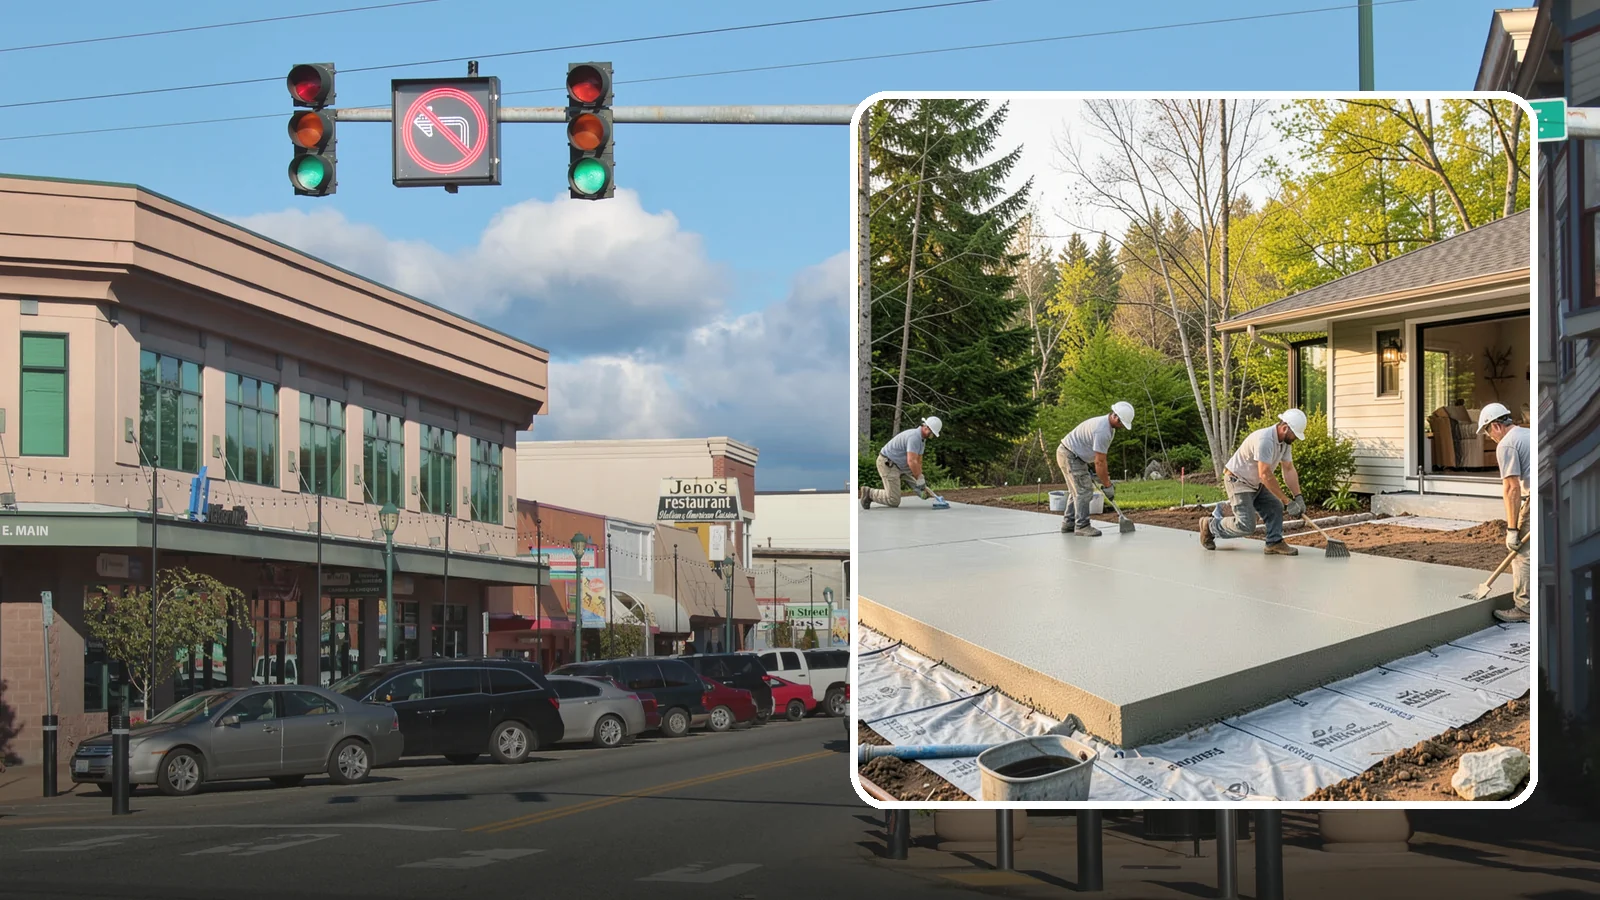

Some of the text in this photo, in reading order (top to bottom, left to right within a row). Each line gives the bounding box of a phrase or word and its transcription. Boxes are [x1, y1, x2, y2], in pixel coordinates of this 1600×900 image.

[670, 480, 727, 494] Jeno's
[665, 496, 731, 509] restaurant
[658, 509, 681, 519] Italian
[686, 509, 714, 519] American
[715, 509, 737, 519] Cuisine
[2, 525, 49, 536] E. MAIN
[797, 607, 829, 617] Street
[791, 619, 824, 627] lass
